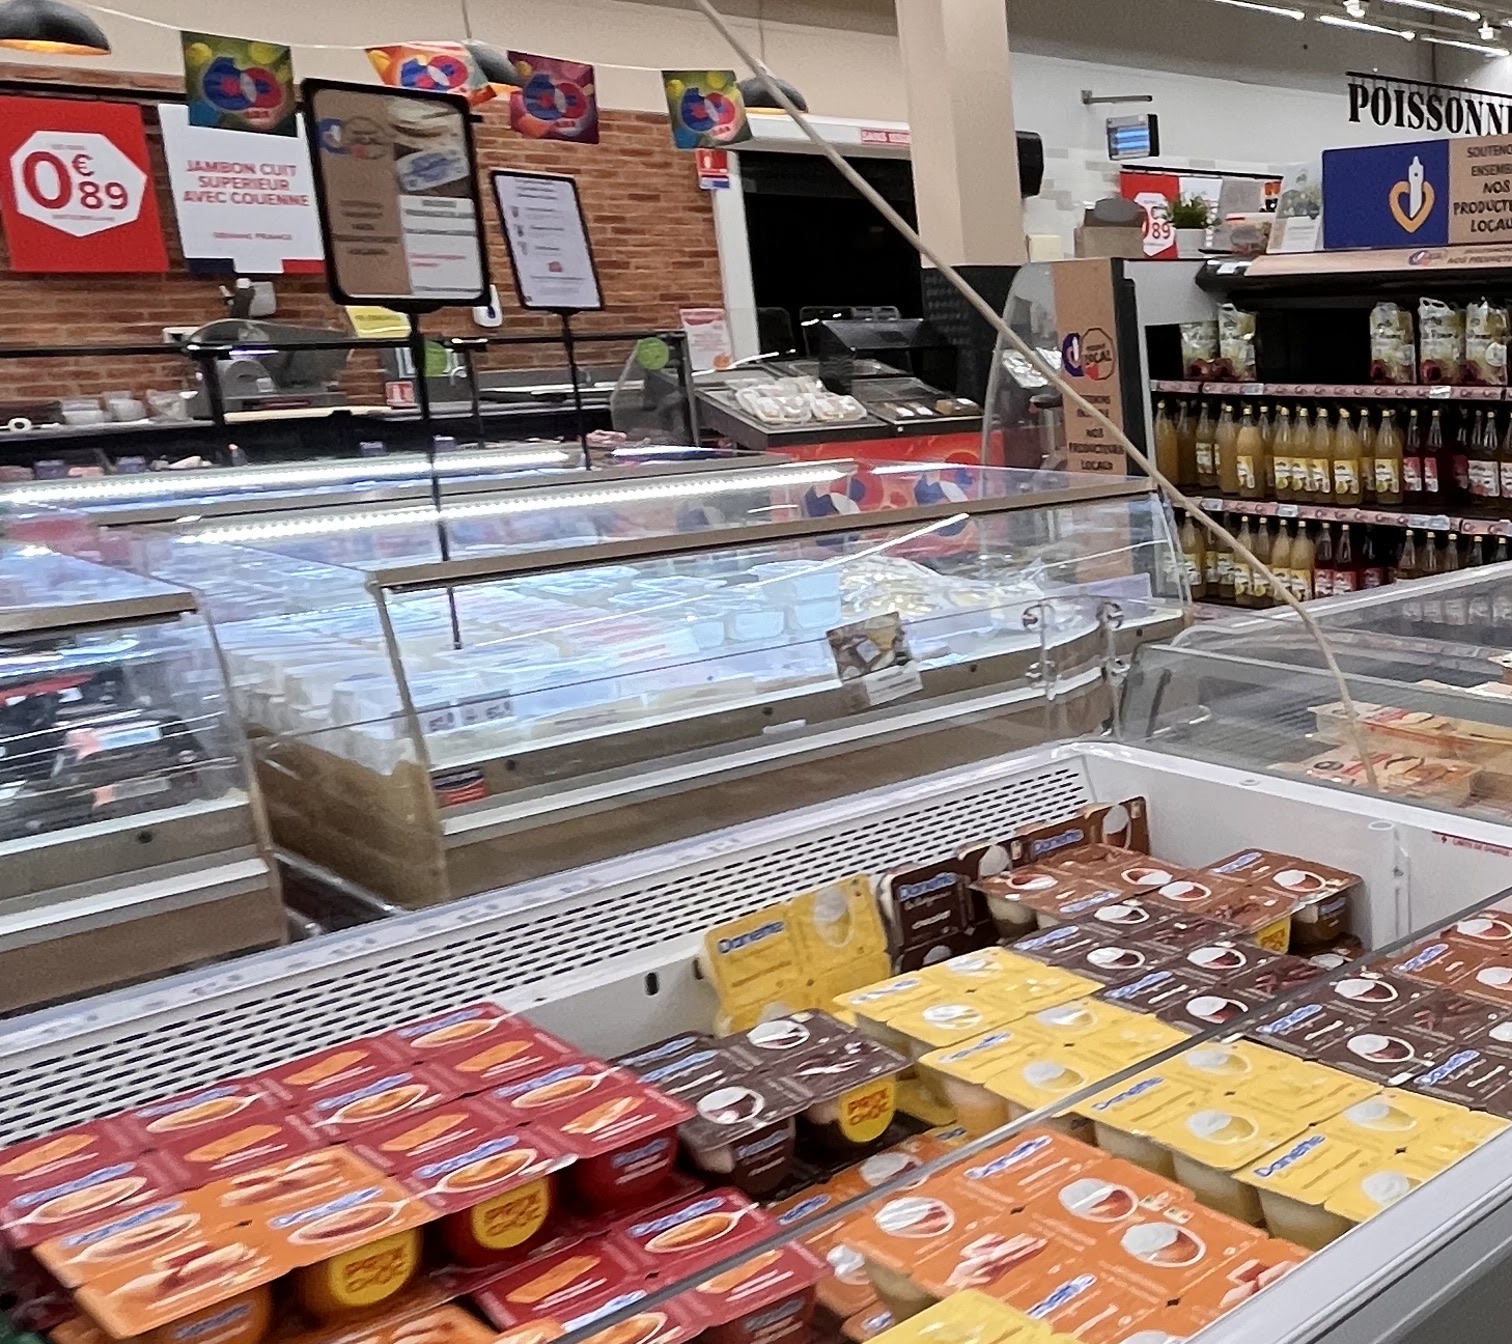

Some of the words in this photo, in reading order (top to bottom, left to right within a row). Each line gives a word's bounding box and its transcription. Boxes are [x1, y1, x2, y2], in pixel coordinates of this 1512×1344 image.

[186, 160, 255, 174] JAMBON
[260, 163, 297, 177] CUIT
[1483, 180, 1511, 194] NOS
[183, 191, 228, 204] AVEC
[231, 192, 310, 207] COUENNE
